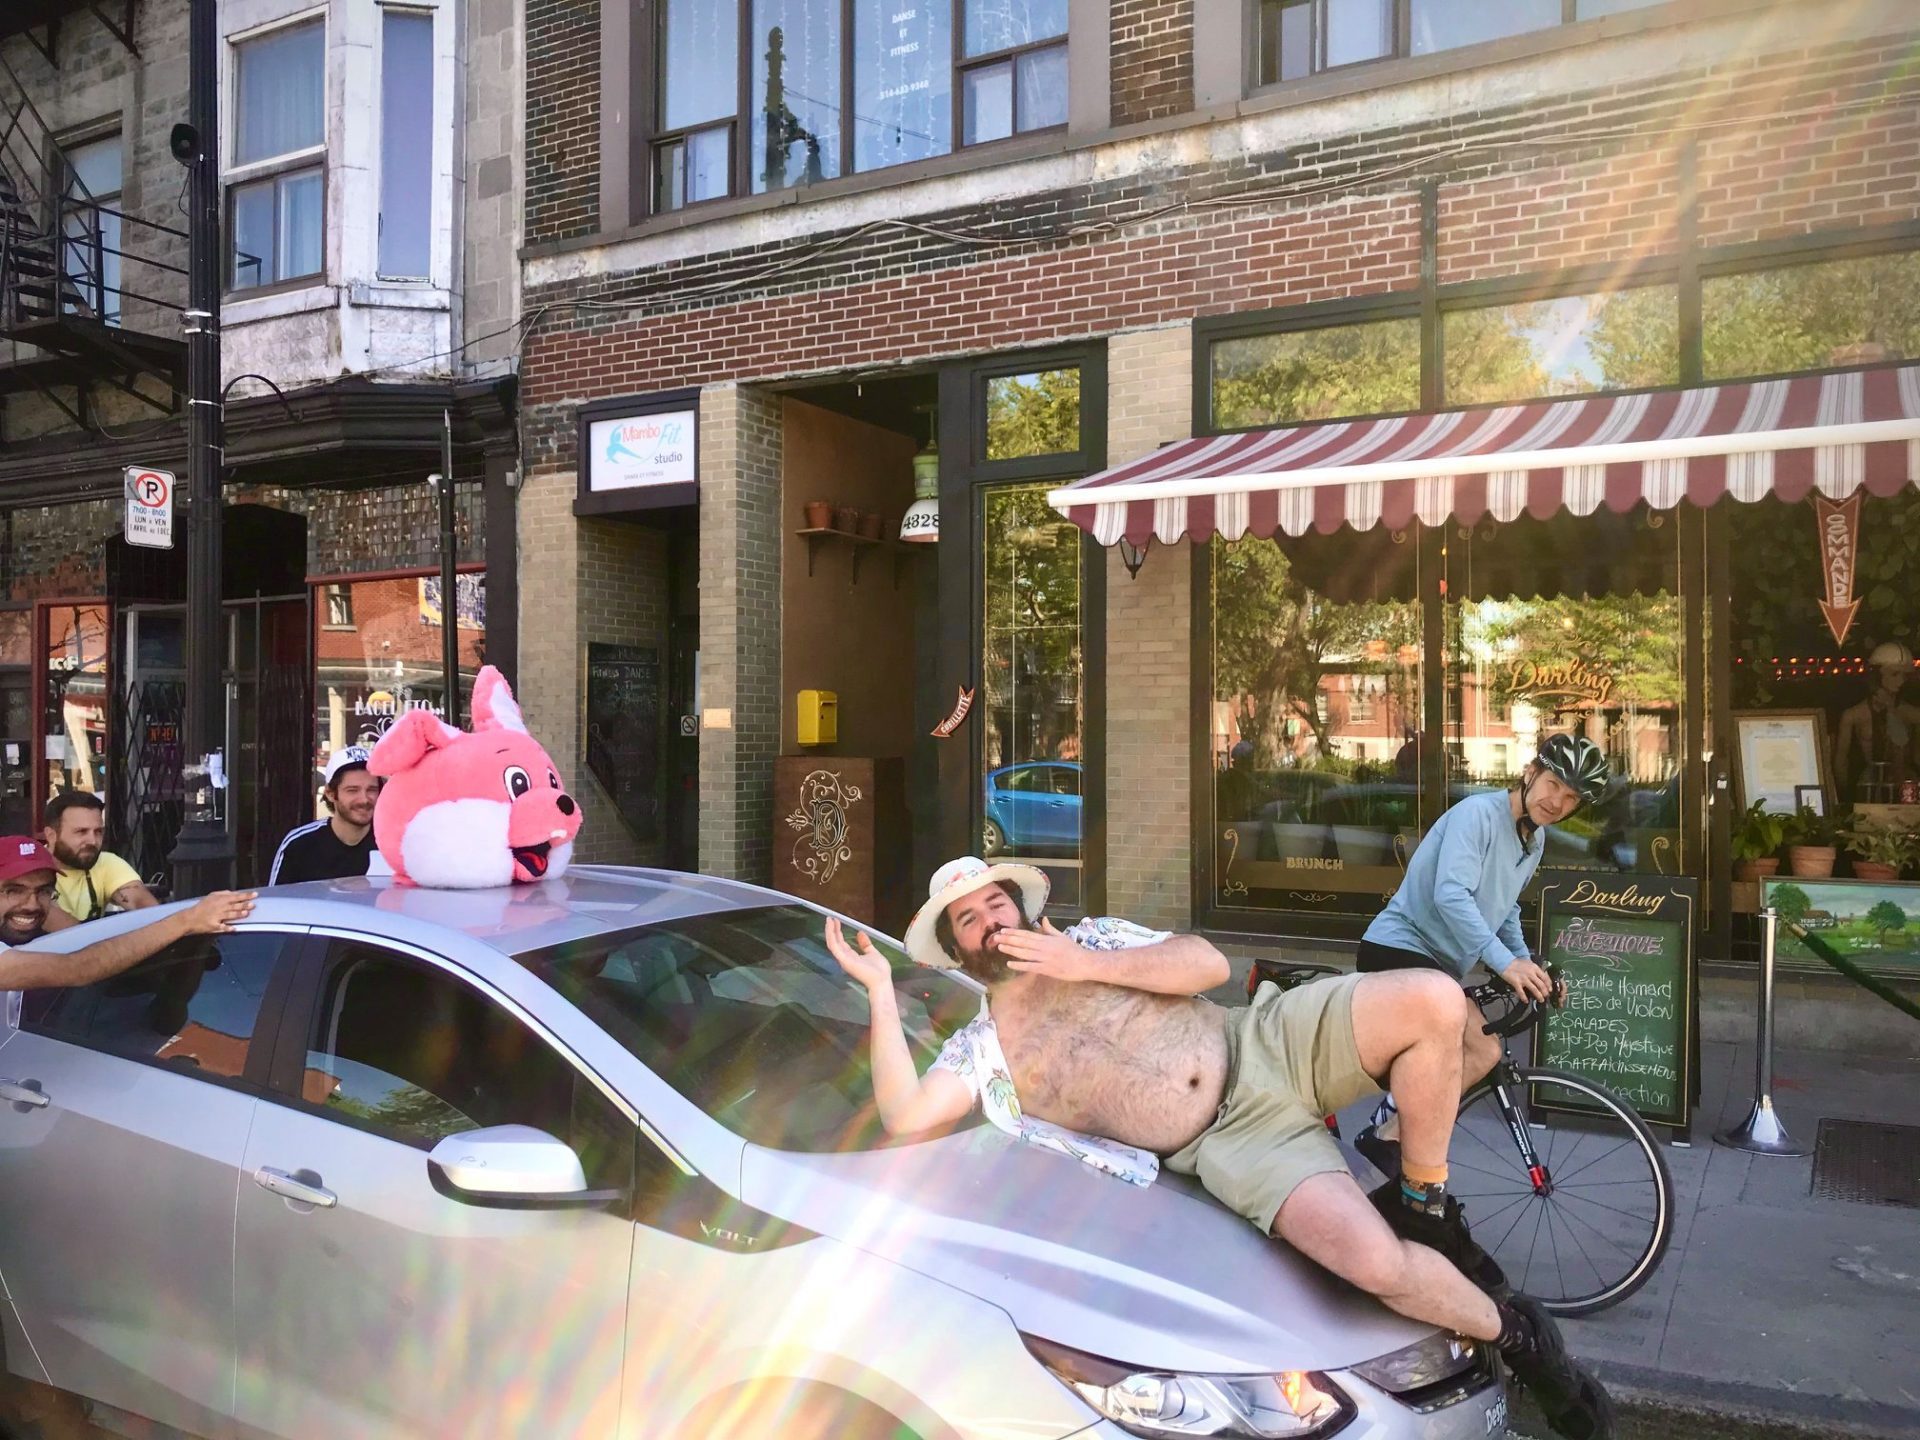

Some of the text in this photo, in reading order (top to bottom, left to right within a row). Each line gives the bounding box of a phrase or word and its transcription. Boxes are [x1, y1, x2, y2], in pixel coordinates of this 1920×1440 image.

[622, 422, 682, 447] Mambo Fit
[654, 451, 683, 465] studio
[147, 481, 158, 499] P
[135, 515, 147, 524] LUN
[155, 517, 167, 526] VEN
[1826, 513, 1850, 609] COMMANDE
[1505, 657, 1612, 704] Darling
[1286, 856, 1344, 871] BRUNCH
[1559, 879, 1667, 915] Darling
[1618, 976, 1672, 999] Homard
[1606, 996, 1622, 1010] de
[1561, 1011, 1630, 1034] SALADES
[699, 1219, 759, 1246] VOLT
